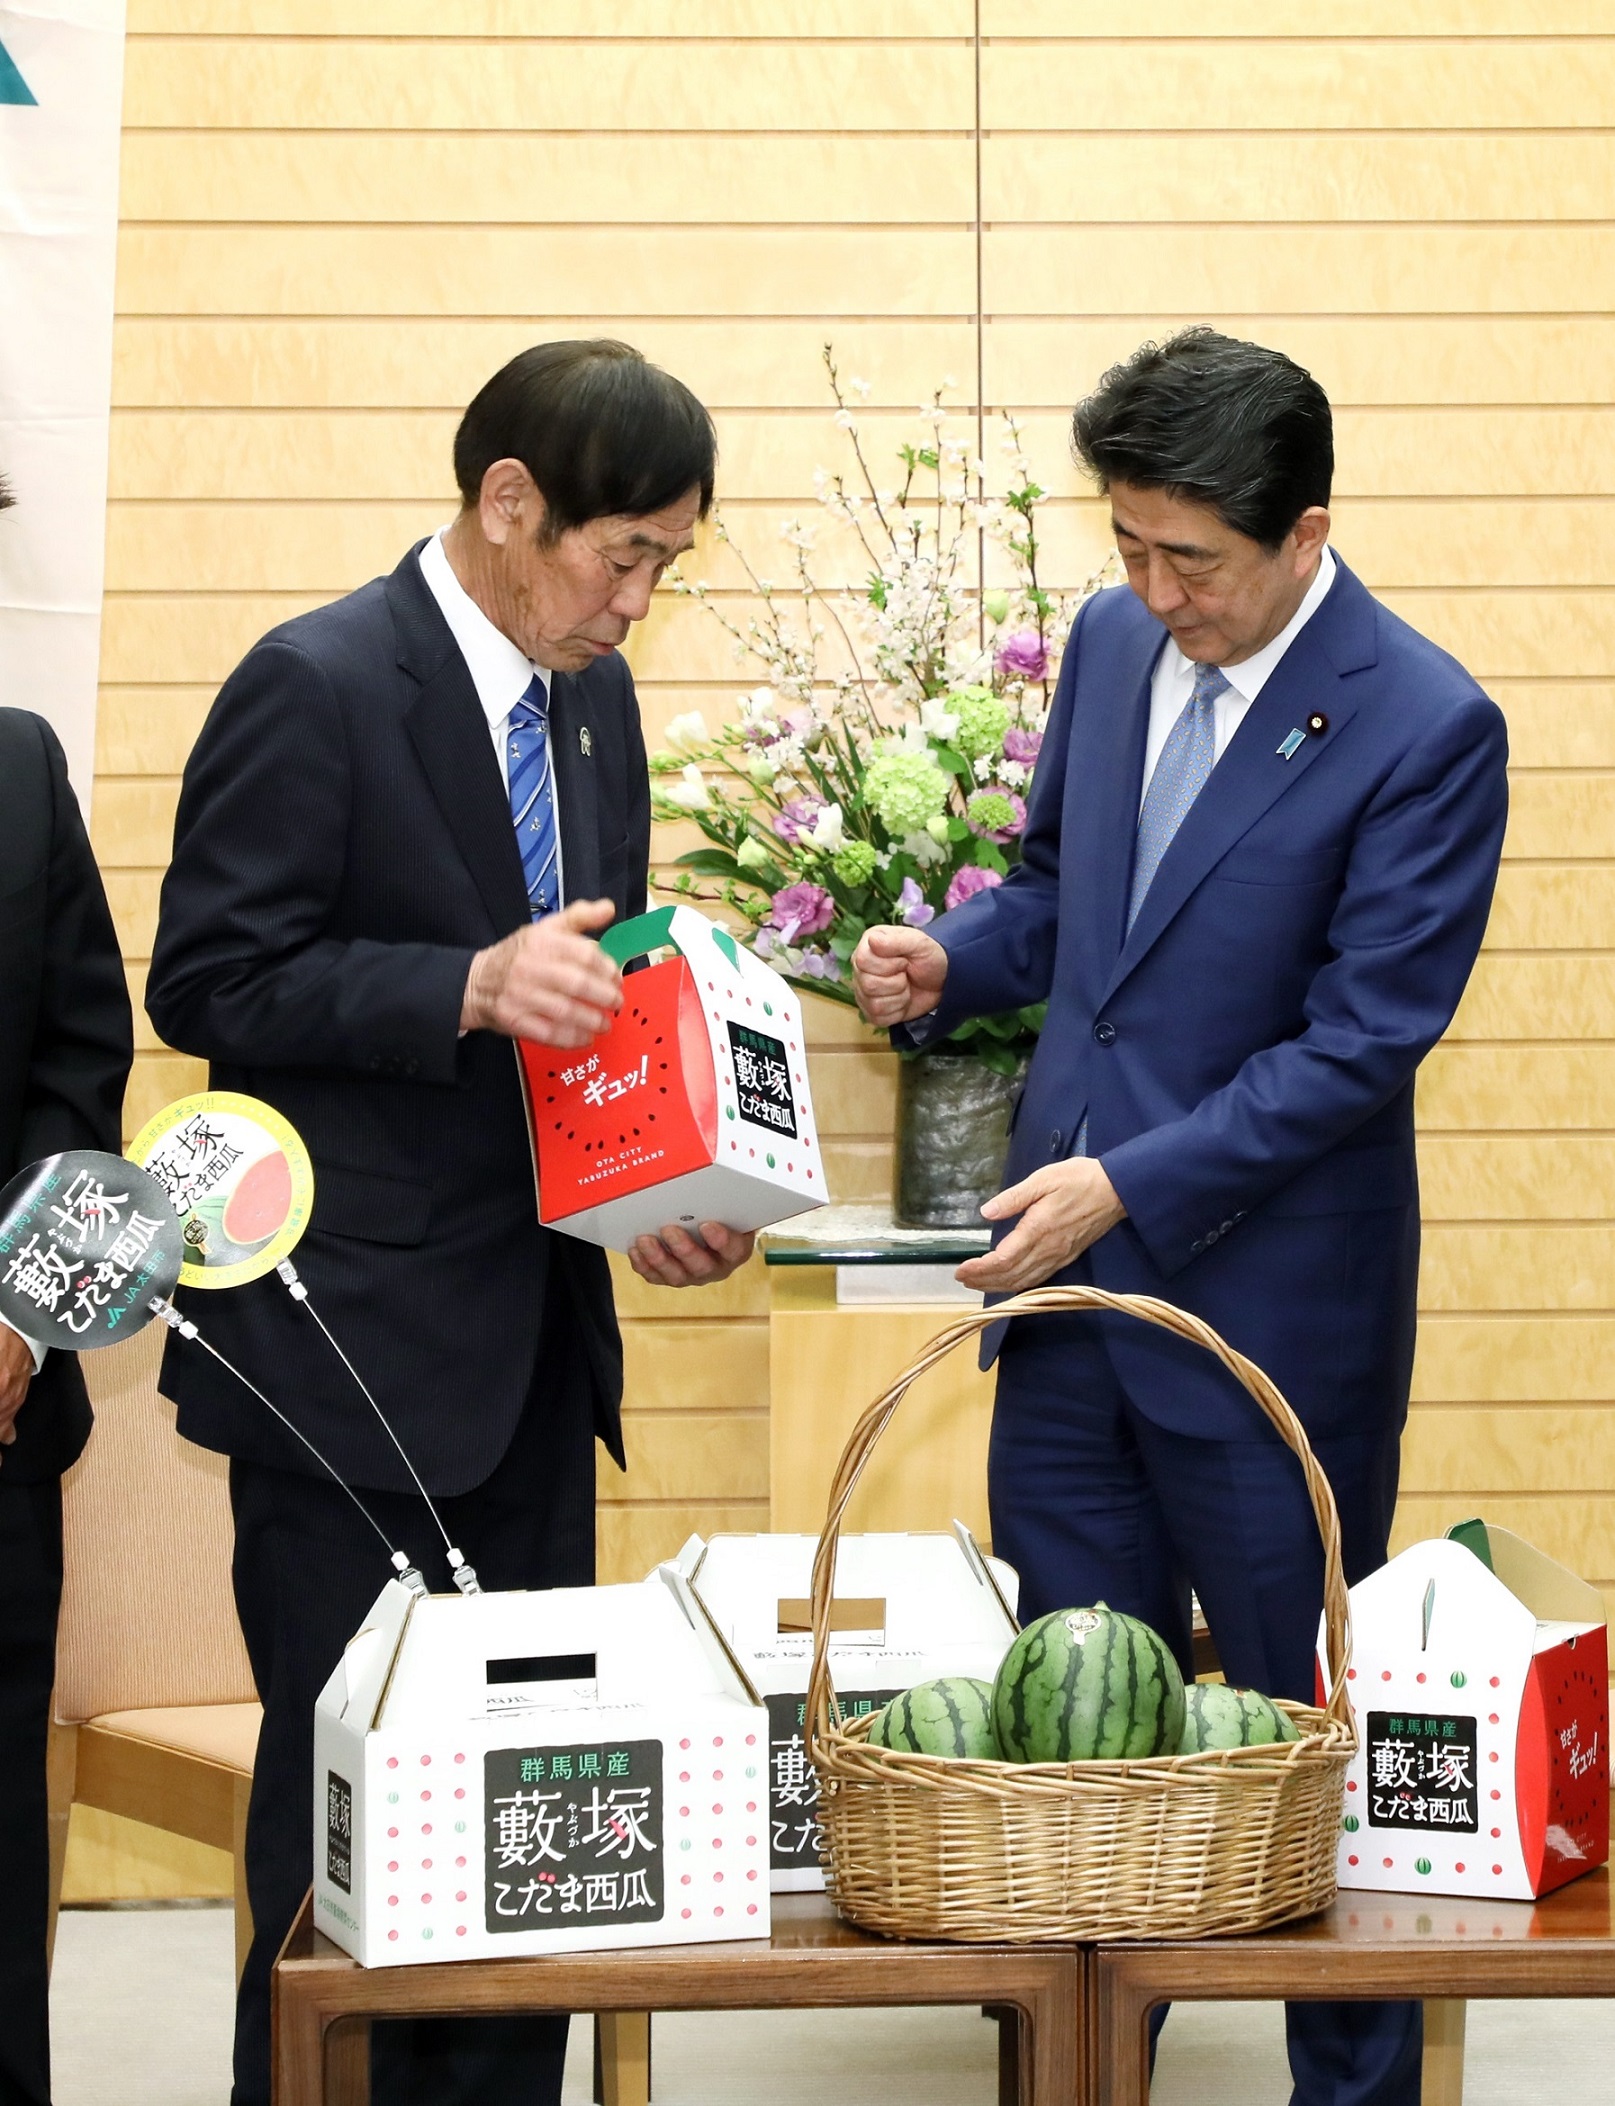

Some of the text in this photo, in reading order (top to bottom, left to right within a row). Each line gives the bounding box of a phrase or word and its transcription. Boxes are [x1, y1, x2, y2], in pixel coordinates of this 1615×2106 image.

[560, 1054, 600, 1086] 甘さが
[582, 1055, 648, 1107] ギュッ!
[739, 1091, 796, 1132] こだま西瓜
[577, 1150, 664, 1185] YABUZUKA BRAND
[596, 1146, 643, 1168] OTA CITY
[173, 1143, 244, 1217] こだま西瓜
[57, 1210, 166, 1333] こだま西瓜
[1389, 1718, 1458, 1738] 群馬県産
[520, 1752, 630, 1783] 群馬県産
[1569, 1731, 1599, 1780] ギュッ!
[1372, 1792, 1474, 1826] こだま西瓜
[493, 1868, 657, 1916] こだま西瓜
